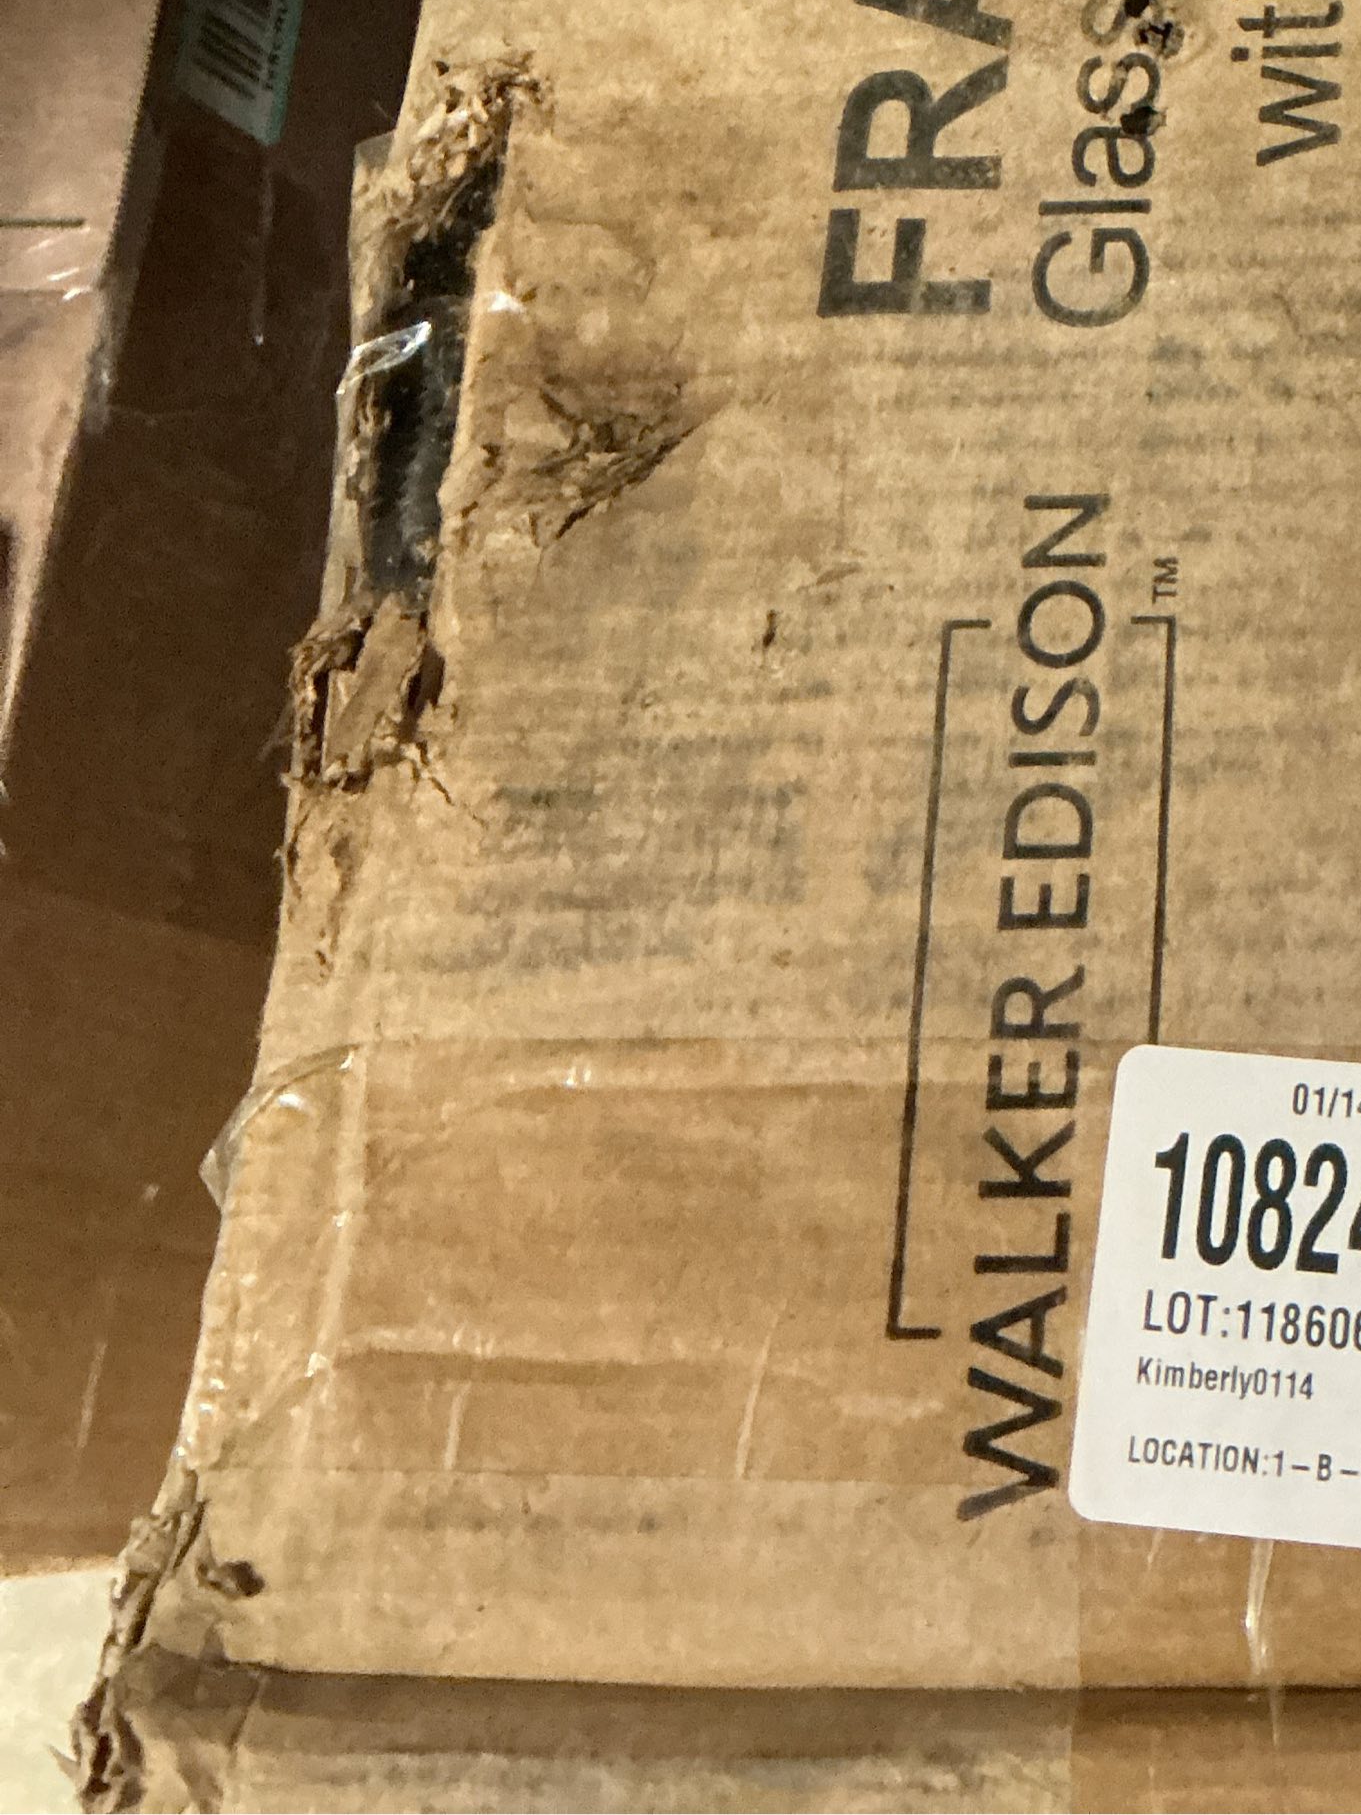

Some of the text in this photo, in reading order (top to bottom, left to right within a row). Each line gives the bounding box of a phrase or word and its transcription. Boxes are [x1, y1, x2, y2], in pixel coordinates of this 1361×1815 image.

[957, 492, 1112, 1522] WALKER EDISON
[1137, 1356, 1315, 1400] Kimberly0114
